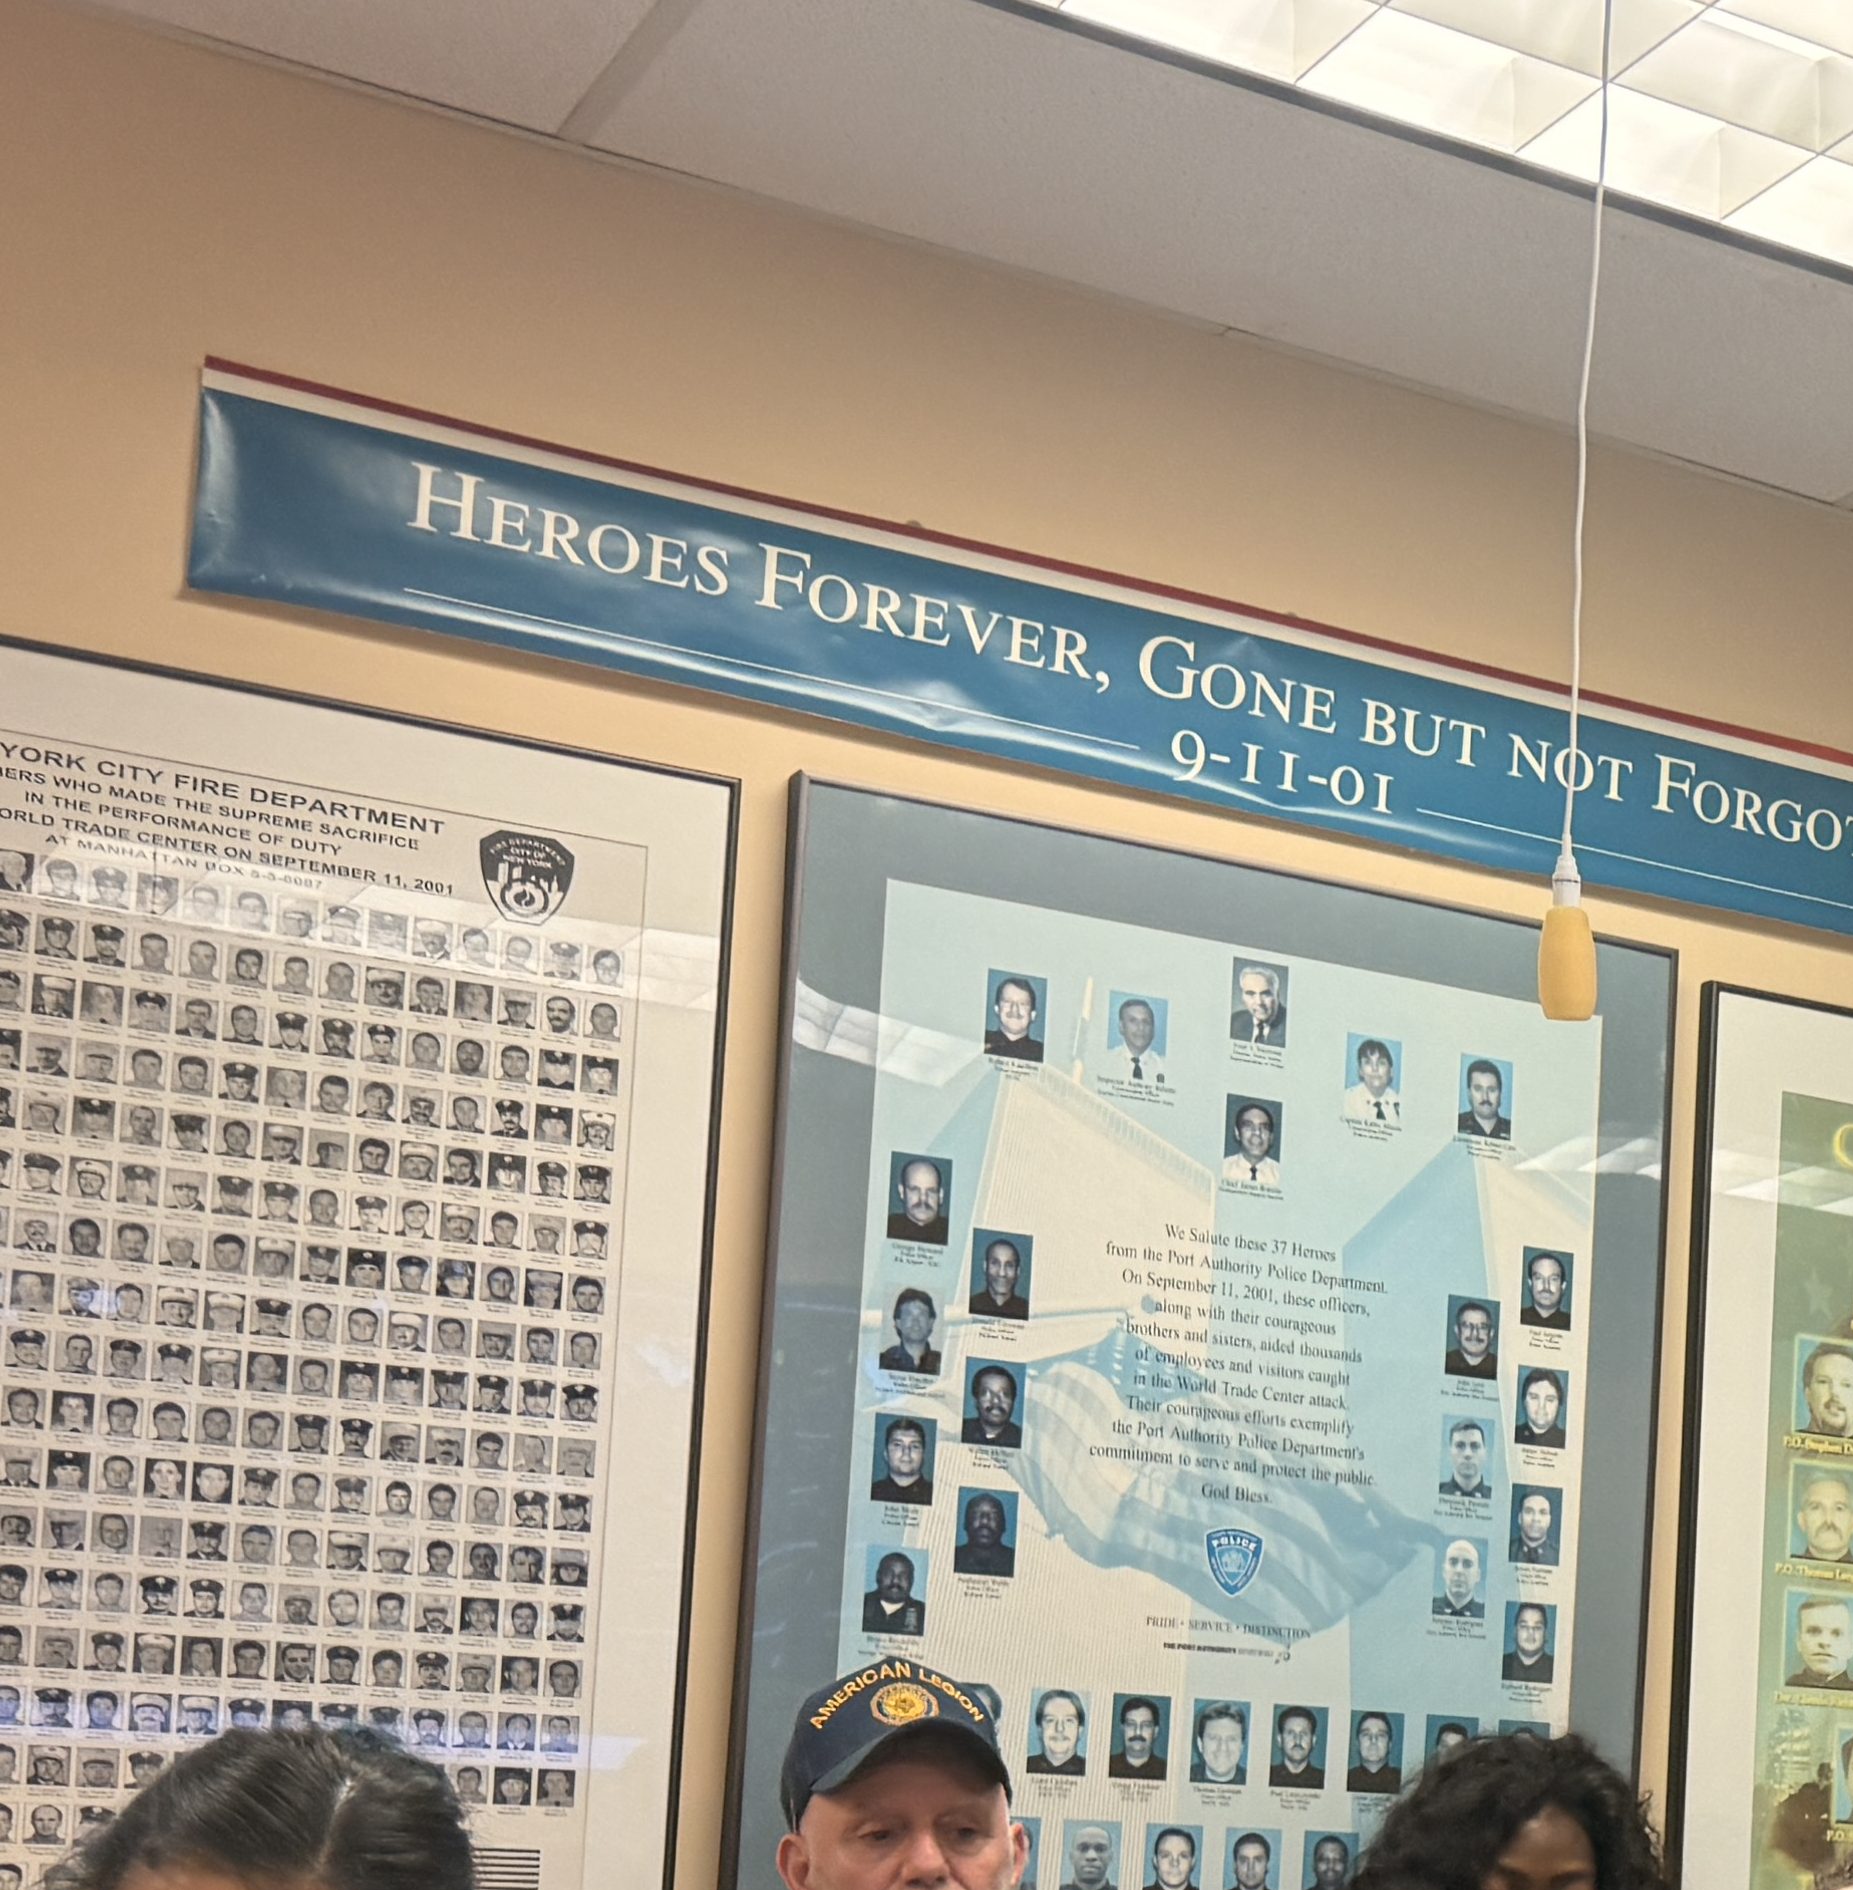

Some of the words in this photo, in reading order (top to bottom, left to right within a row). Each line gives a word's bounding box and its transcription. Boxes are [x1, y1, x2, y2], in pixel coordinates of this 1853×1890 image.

[408, 462, 729, 597] HEROES
[755, 543, 1109, 694] FOREVER,
[1140, 633, 1336, 735] GONE
[1361, 698, 1485, 767] BUT
[1510, 732, 1632, 801] NOT
[0, 743, 87, 772] YORK
[97, 760, 163, 785] CITY
[174, 773, 241, 799] FIRE
[249, 787, 446, 835] DEPARTMENT
[1170, 729, 1394, 815] 9-11-01
[25, 790, 44, 805] IN
[52, 795, 92, 813] THE
[99, 804, 251, 840] PERFORMANCE
[258, 832, 284, 846] OF
[290, 837, 342, 856] DUTY
[53, 775, 102, 794] WHO
[108, 785, 166, 807] MADE
[173, 797, 212, 814] THE
[219, 806, 313, 833] SUPREME
[319, 823, 420, 850] SACRIFICE
[62, 817, 130, 840] TRADE
[137, 831, 217, 856] CENTER
[224, 845, 252, 861] ON
[259, 852, 377, 883] SEPTEMBER
[414, 878, 454, 896] 2001
[1106, 1240, 1138, 1259] from
[1143, 1245, 1163, 1262] the
[1168, 1249, 1195, 1268] Port
[1200, 1254, 1263, 1279] Authority
[1267, 1262, 1307, 1283] Police
[1164, 1223, 1185, 1242] We
[1189, 1228, 1231, 1248] Salute
[1234, 1232, 1267, 1253] these
[1271, 1238, 1288, 1255] 37
[1292, 1242, 1337, 1263] Heroes
[1122, 1267, 1142, 1285] On
[1146, 1271, 1217, 1296] September
[1221, 1281, 1239, 1299] 11,
[1243, 1285, 1278, 1305] 2001,
[1282, 1290, 1315, 1309] these
[1319, 1295, 1371, 1317] officers,
[1125, 1317, 1180, 1340] brothers
[1183, 1326, 1208, 1343] and
[1211, 1331, 1257, 1352] sisters,
[1259, 1335, 1295, 1354] aided
[1299, 1341, 1364, 1364] thousands
[1154, 1300, 1192, 1321] along
[1196, 1305, 1226, 1322] with
[1230, 1308, 1260, 1326] their
[1264, 1316, 1337, 1337] courageous
[1133, 1371, 1147, 1386] in
[1151, 1372, 1174, 1389] the
[1177, 1375, 1217, 1395] World
[1221, 1381, 1259, 1400] Trade
[1262, 1386, 1305, 1405] Center
[1134, 1346, 1152, 1361] of
[1154, 1350, 1226, 1371] employees
[1228, 1357, 1253, 1375] and
[1257, 1360, 1305, 1381] visitors
[1307, 1367, 1352, 1388] caught
[1126, 1394, 1161, 1413] Their
[1166, 1401, 1241, 1422] courageous
[1243, 1408, 1287, 1428] efforts
[1289, 1415, 1356, 1440] exemplify
[1111, 1419, 1133, 1436] the
[1137, 1420, 1165, 1439] Port
[1170, 1425, 1233, 1450] Authority
[1237, 1432, 1279, 1452] Police
[1281, 1437, 1366, 1461] Department's
[1089, 1443, 1174, 1466] commitment
[1178, 1451, 1192, 1467] to
[1194, 1454, 1230, 1471] serve
[1232, 1457, 1258, 1475] and
[1261, 1461, 1307, 1480] protect
[1310, 1464, 1331, 1482] the
[1200, 1482, 1230, 1501] God
[1211, 1535, 1257, 1552] POLICE
[1146, 1616, 1179, 1629] PRIDE
[1187, 1619, 1233, 1634] SERVICE
[1242, 1622, 1312, 1640] DISTINCTION
[809, 1660, 913, 1730] AMERICAN
[918, 1667, 986, 1722] LEGION
